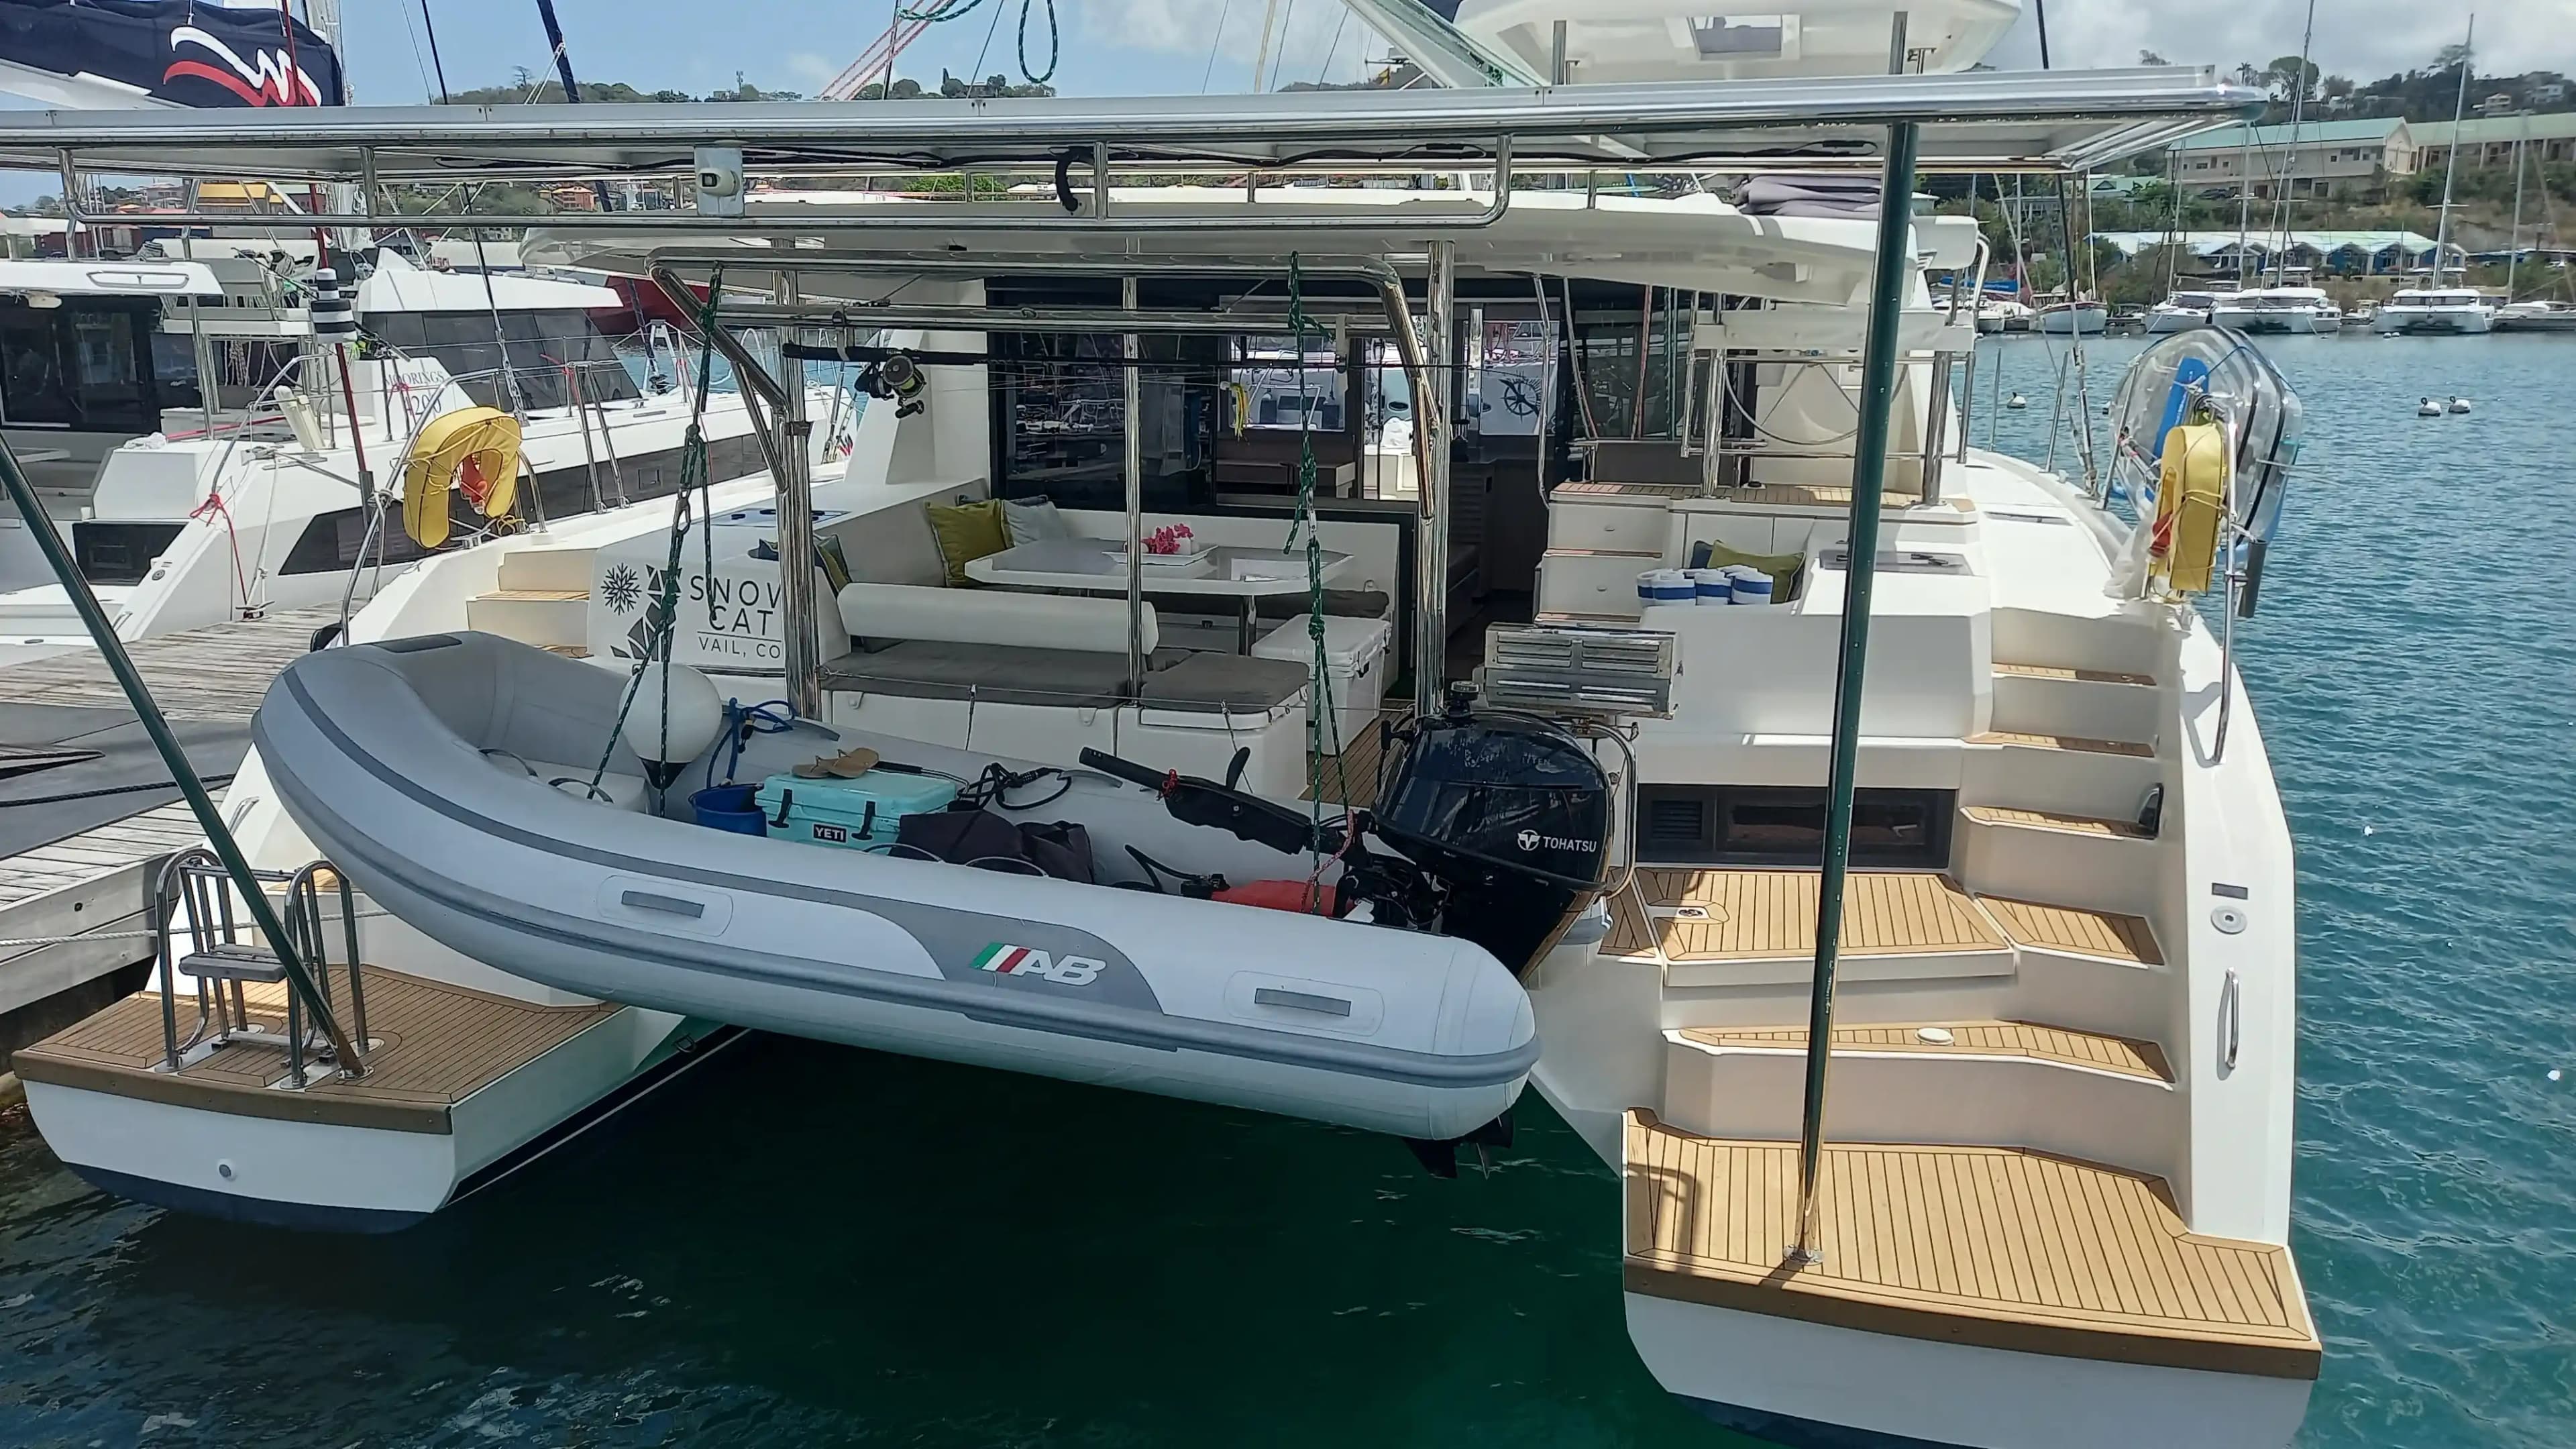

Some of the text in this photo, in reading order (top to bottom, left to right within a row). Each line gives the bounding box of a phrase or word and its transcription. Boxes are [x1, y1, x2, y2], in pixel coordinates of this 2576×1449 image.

[708, 605, 773, 636] CAT
[698, 636, 781, 659] VAIL, CO
[814, 826, 845, 841] YETI
[1543, 836, 1597, 853] TOHATSU
